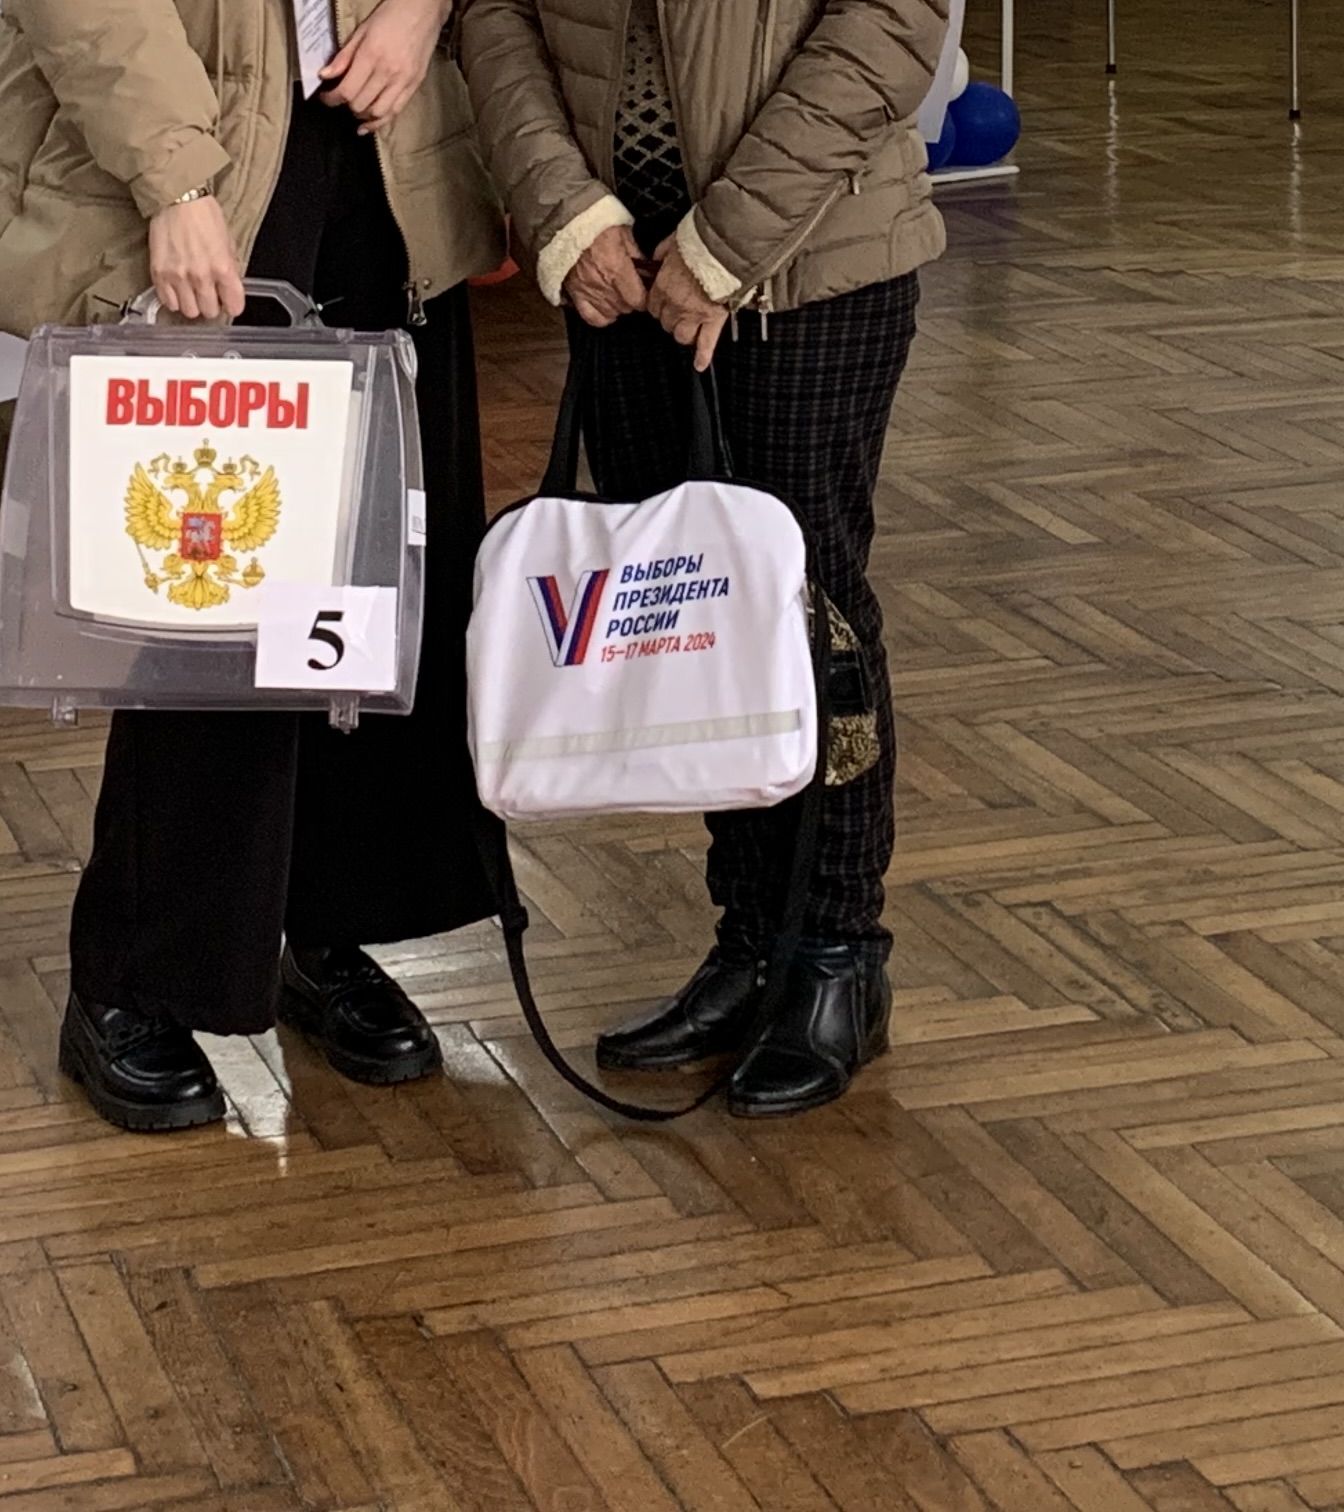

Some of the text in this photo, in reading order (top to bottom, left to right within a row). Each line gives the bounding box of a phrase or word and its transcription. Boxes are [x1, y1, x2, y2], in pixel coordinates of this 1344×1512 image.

[105, 378, 309, 430] ВЫБОРЫ
[620, 553, 705, 585] ВЫБОРЫ
[612, 577, 730, 612] ПРЕЗИДЕНТА
[306, 610, 345, 670] 5
[605, 609, 680, 639] РОССИИ
[637, 638, 681, 659] МАРТА
[683, 631, 717, 652] 2024
